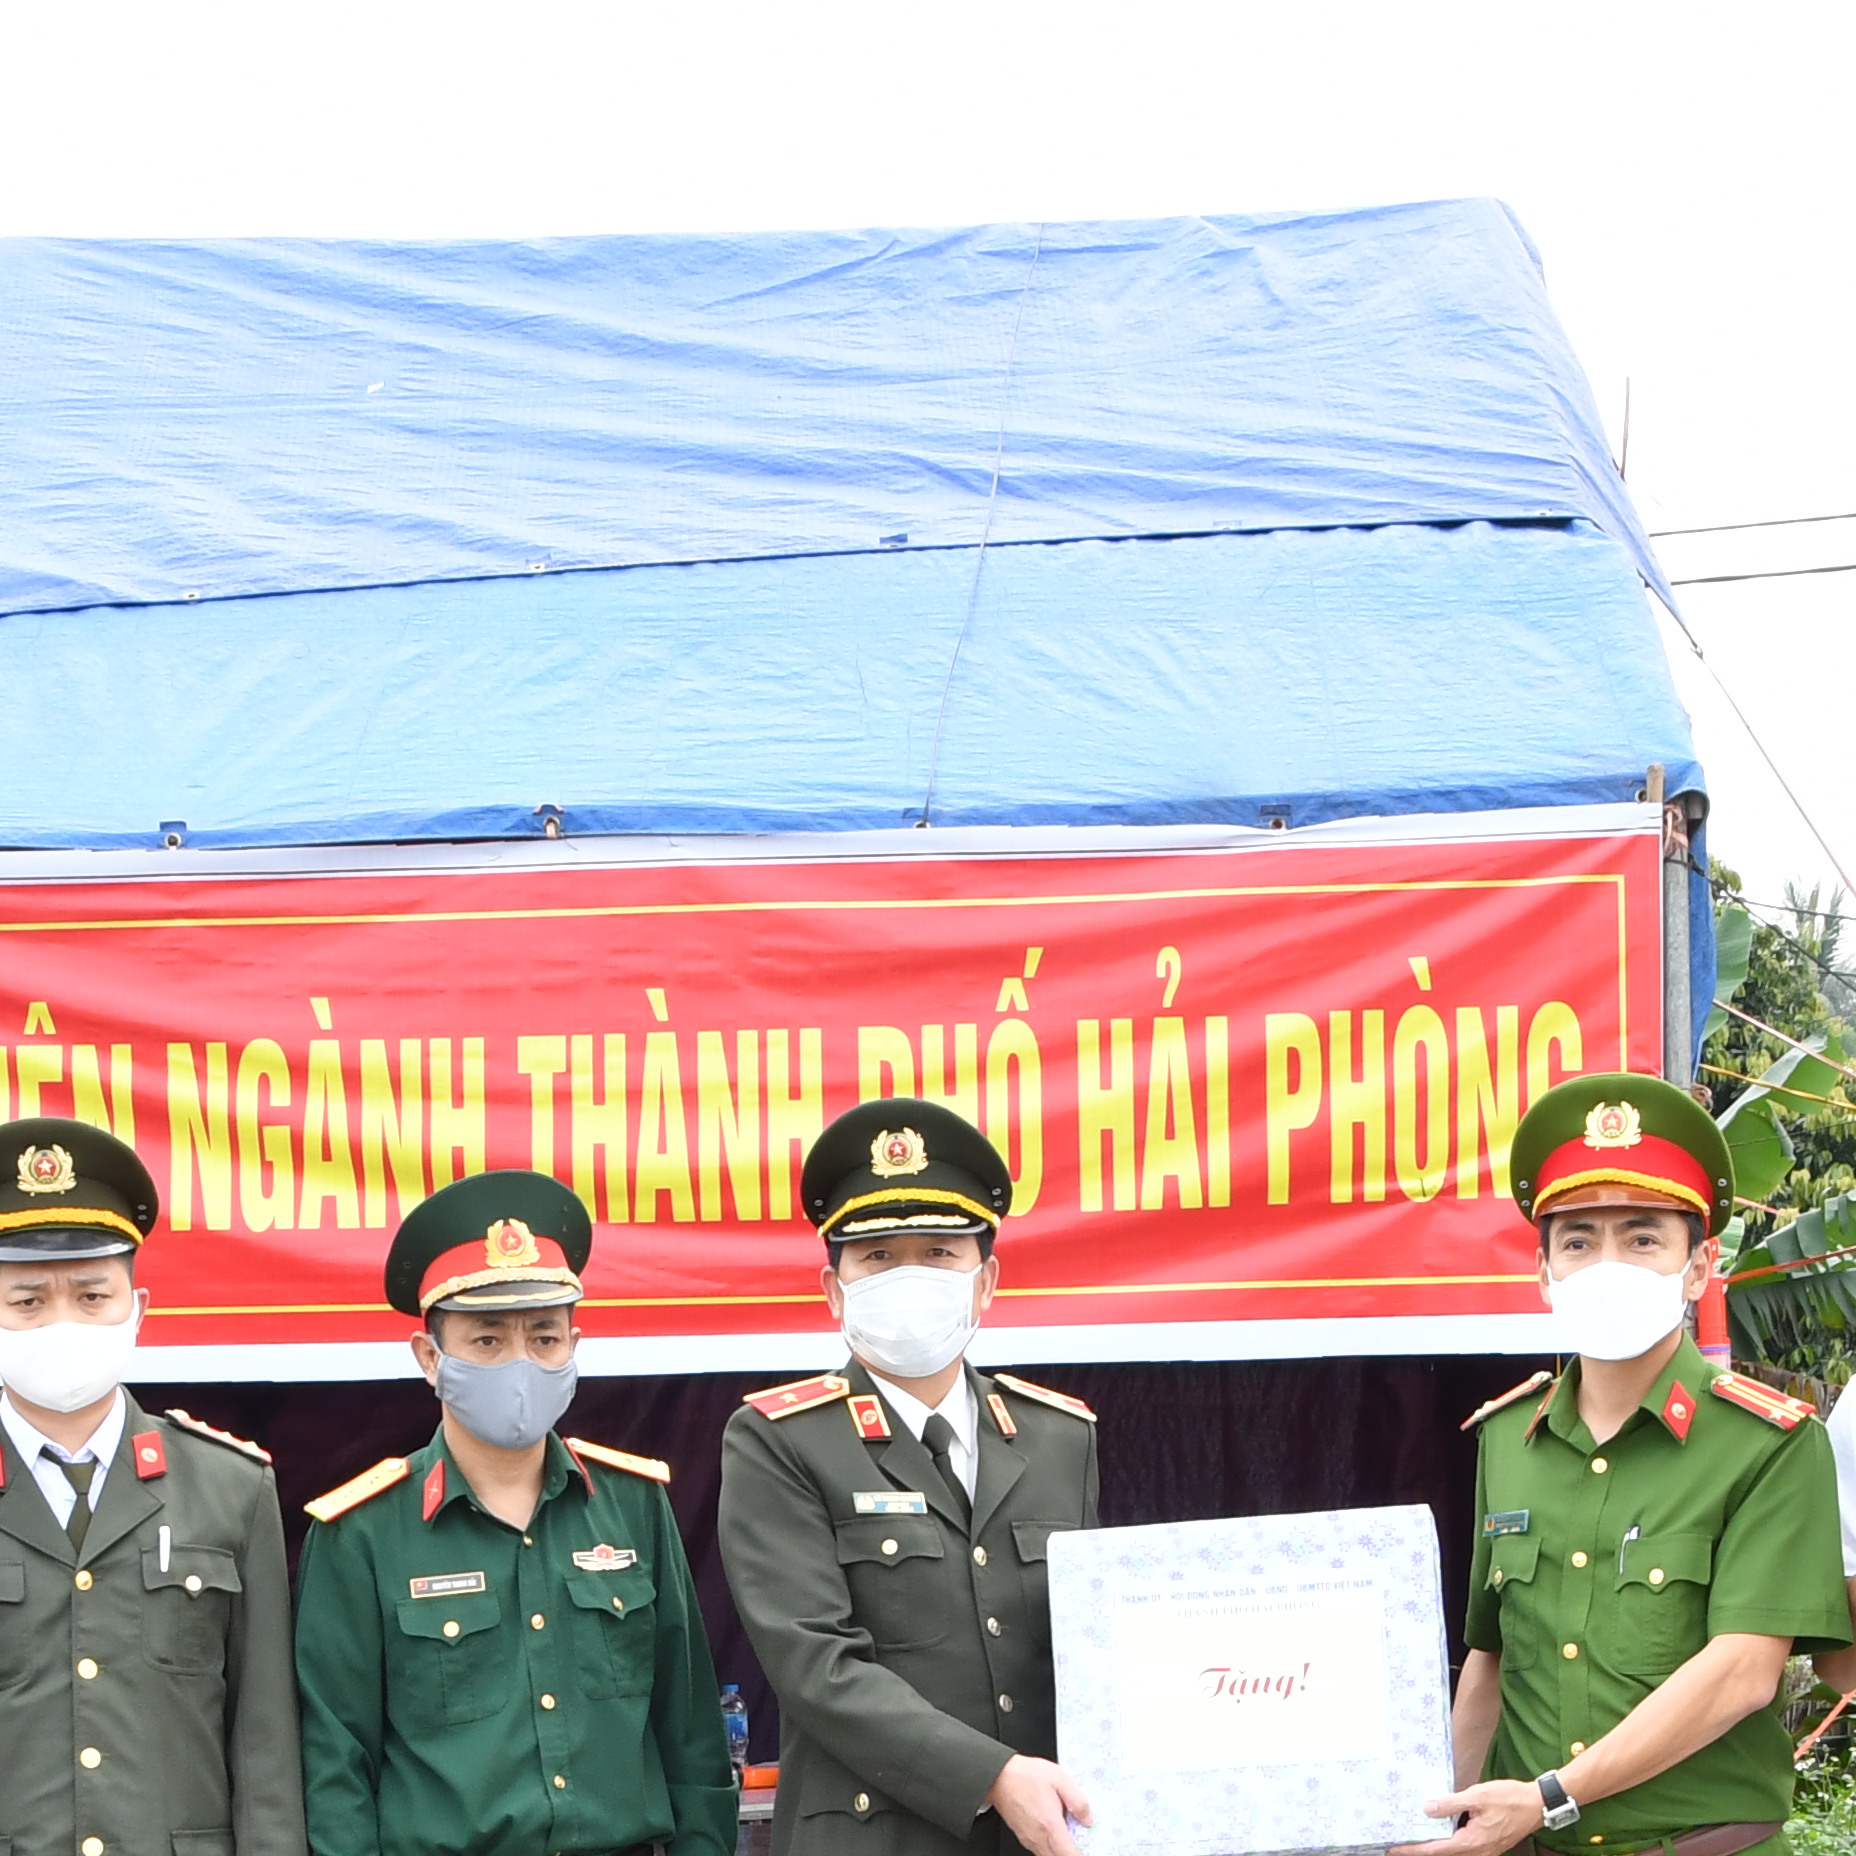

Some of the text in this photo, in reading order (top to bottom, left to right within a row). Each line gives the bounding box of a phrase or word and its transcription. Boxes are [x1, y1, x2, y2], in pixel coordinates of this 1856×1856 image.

[166, 997, 487, 1233] NGÀNH
[517, 988, 825, 1223] THÀNH
[1076, 945, 1232, 1213] HẢI
[1198, 1661, 1311, 1705] Tặng!
